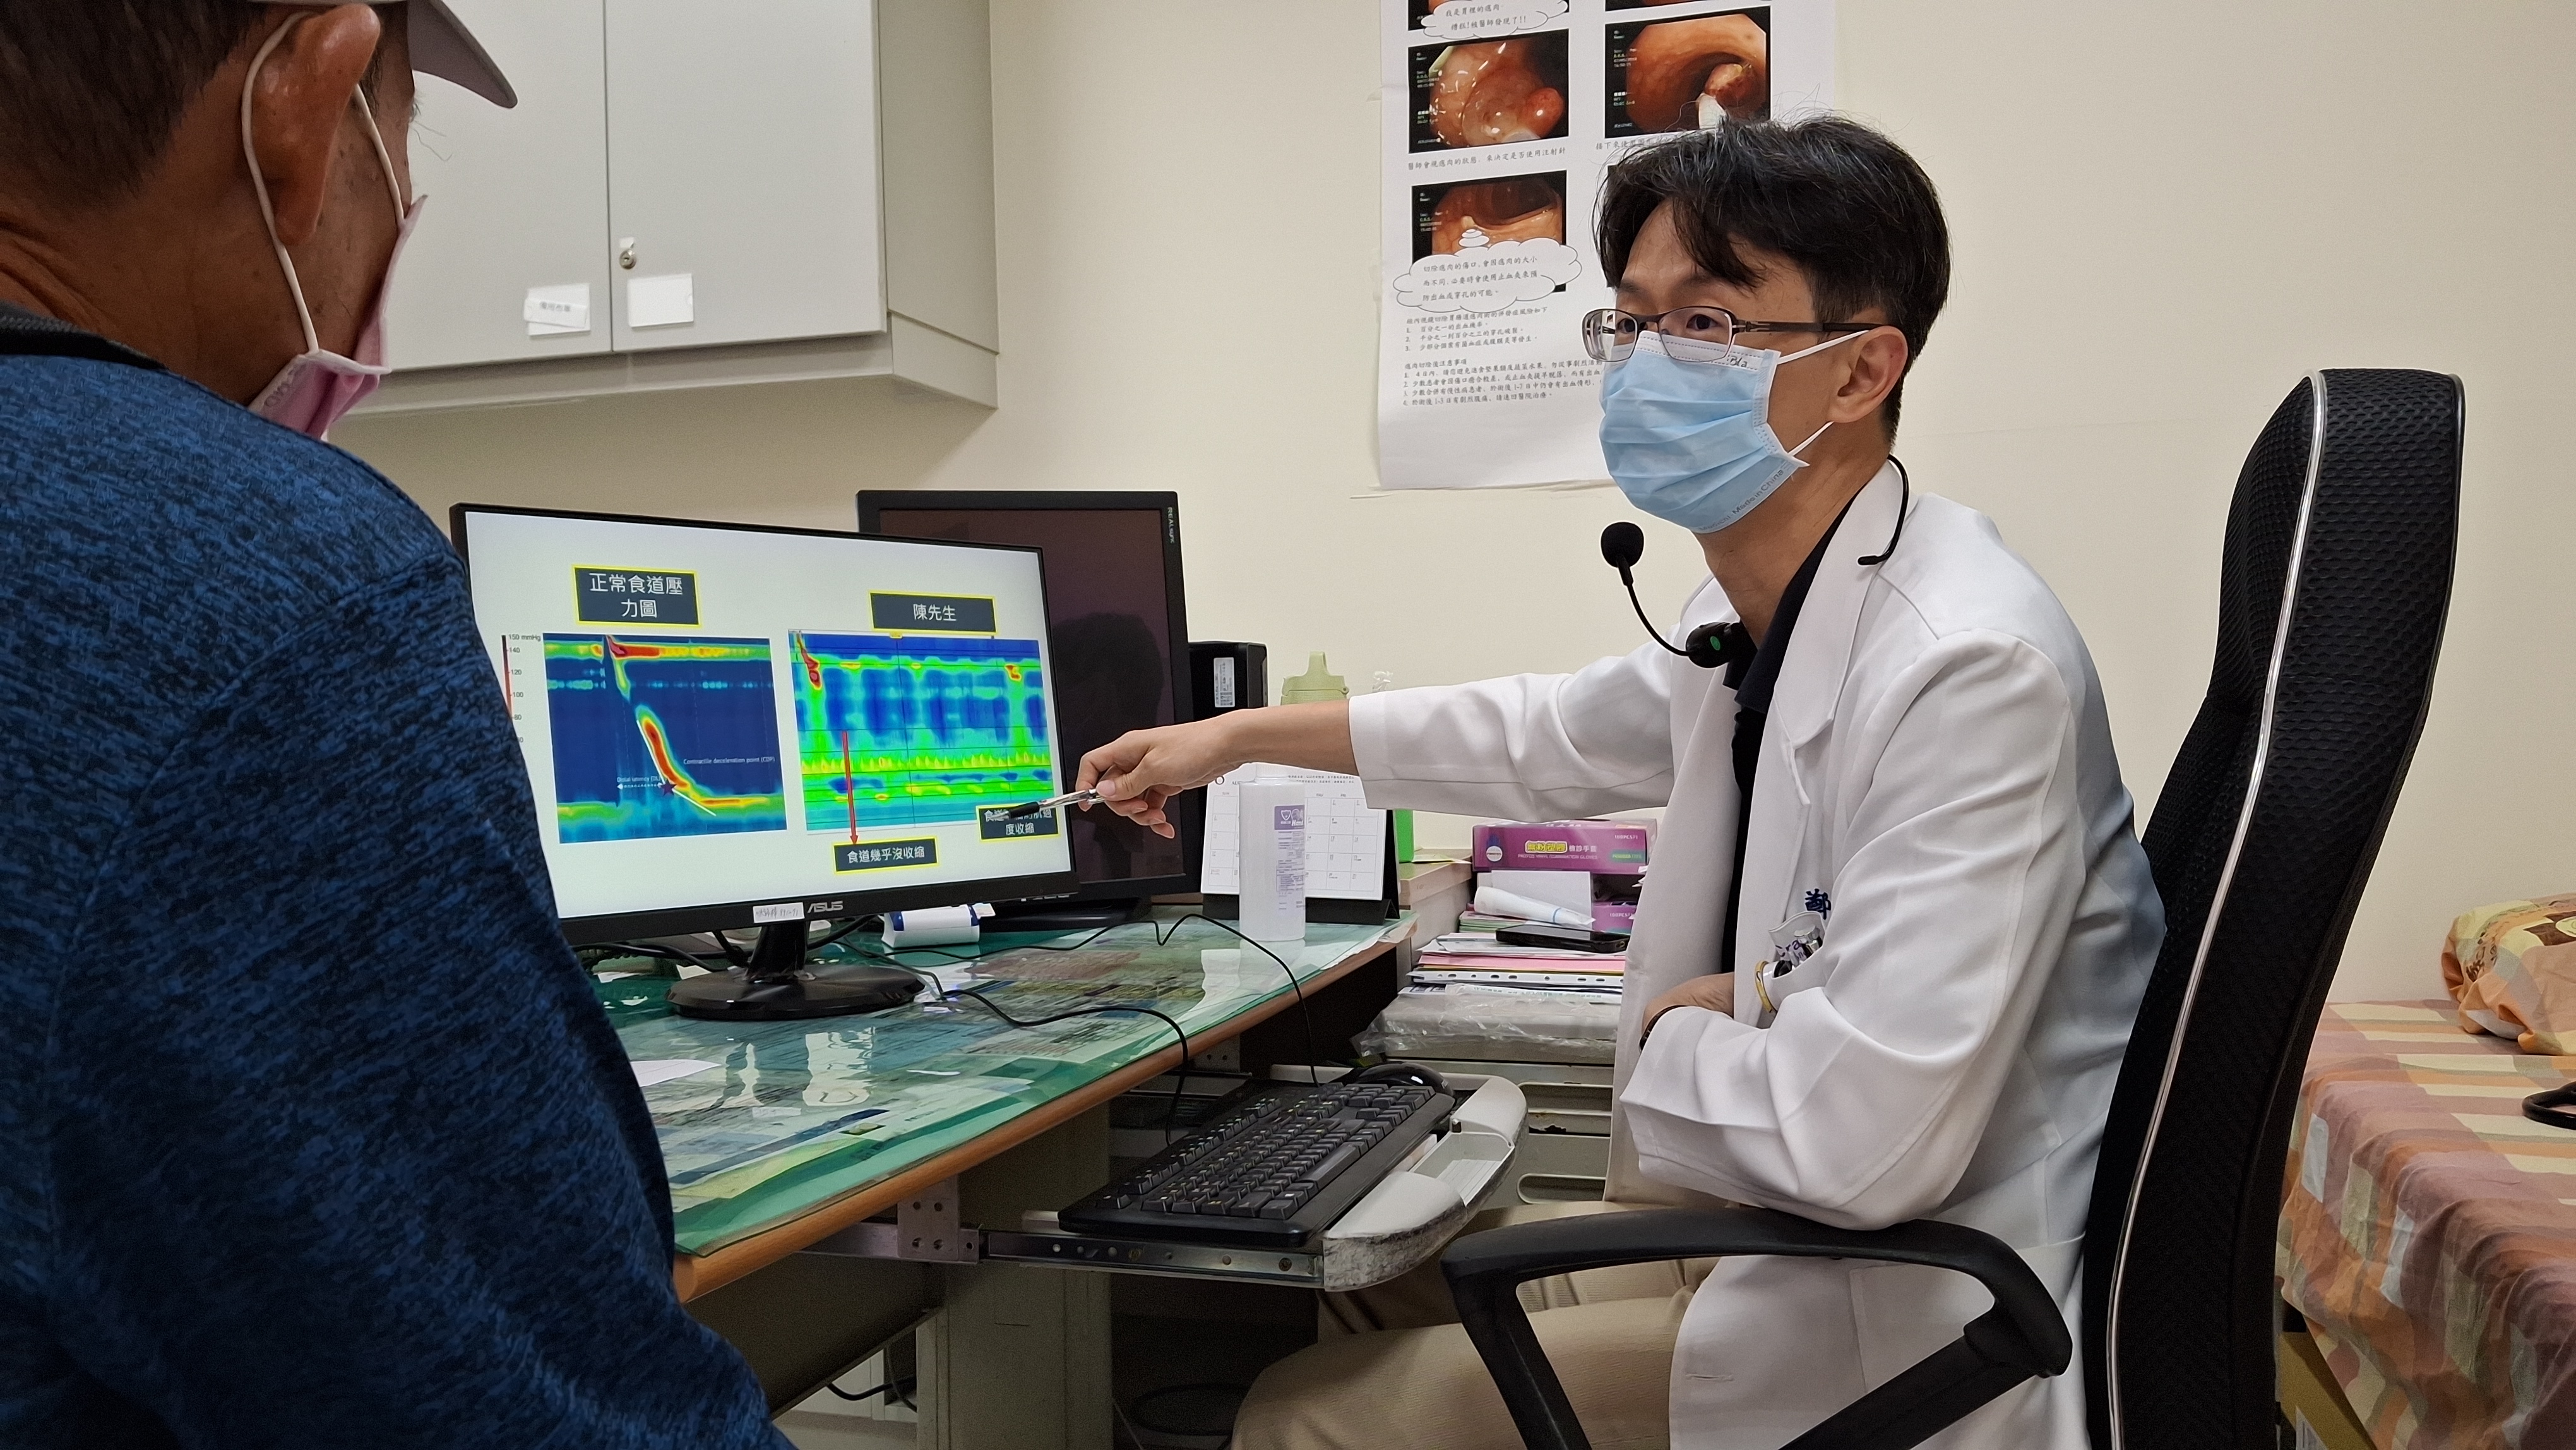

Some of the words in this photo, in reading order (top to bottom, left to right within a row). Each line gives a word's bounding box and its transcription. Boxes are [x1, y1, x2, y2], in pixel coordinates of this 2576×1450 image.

[1761, 469, 1784, 491] China
[588, 572, 683, 596] 正常食道壓
[621, 598, 657, 618] 力圖
[913, 603, 957, 621] 陳先生
[1005, 822, 1035, 836] 度收縮
[847, 846, 925, 864] 食道幾乎沒收縮
[807, 901, 844, 914] ASUS
